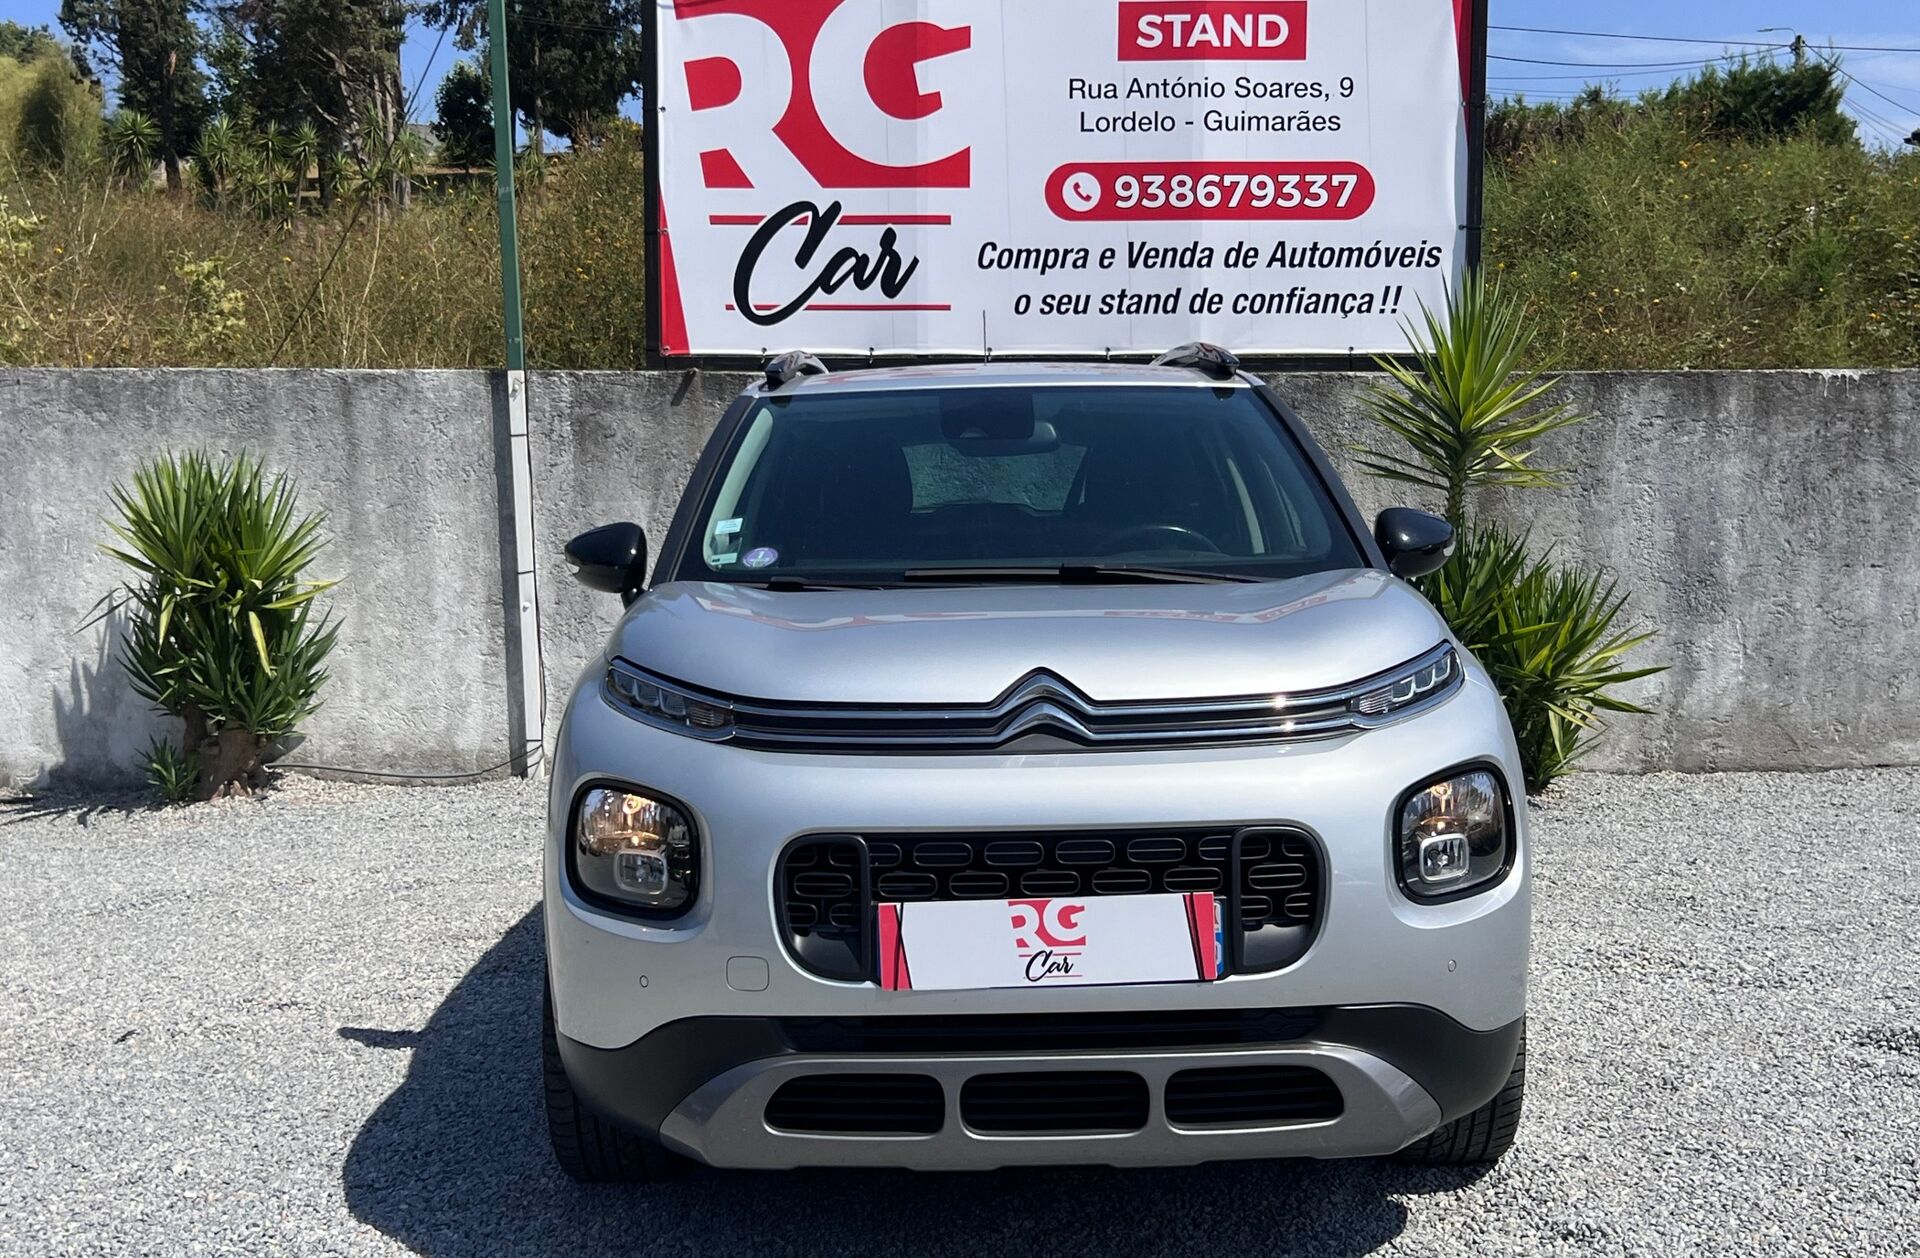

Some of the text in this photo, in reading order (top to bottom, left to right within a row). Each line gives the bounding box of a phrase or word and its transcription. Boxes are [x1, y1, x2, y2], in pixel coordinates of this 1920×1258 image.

[1135, 13, 1290, 48] STAND
[675, 0, 971, 188] RG
[1069, 76, 1354, 102] Rua António Soares, 9
[1080, 111, 1176, 133] Lordelo
[1203, 109, 1341, 132] Guimarães
[1114, 174, 1358, 209] 938679337
[732, 200, 919, 326] Car
[977, 239, 1443, 276] Compra e Venda de Automóveis
[1014, 294, 1031, 316] o
[1039, 294, 1091, 316] seu
[1098, 287, 1182, 315] stand
[1188, 287, 1224, 315] de
[1008, 899, 1087, 948] RG
[1025, 949, 1074, 982] Car
